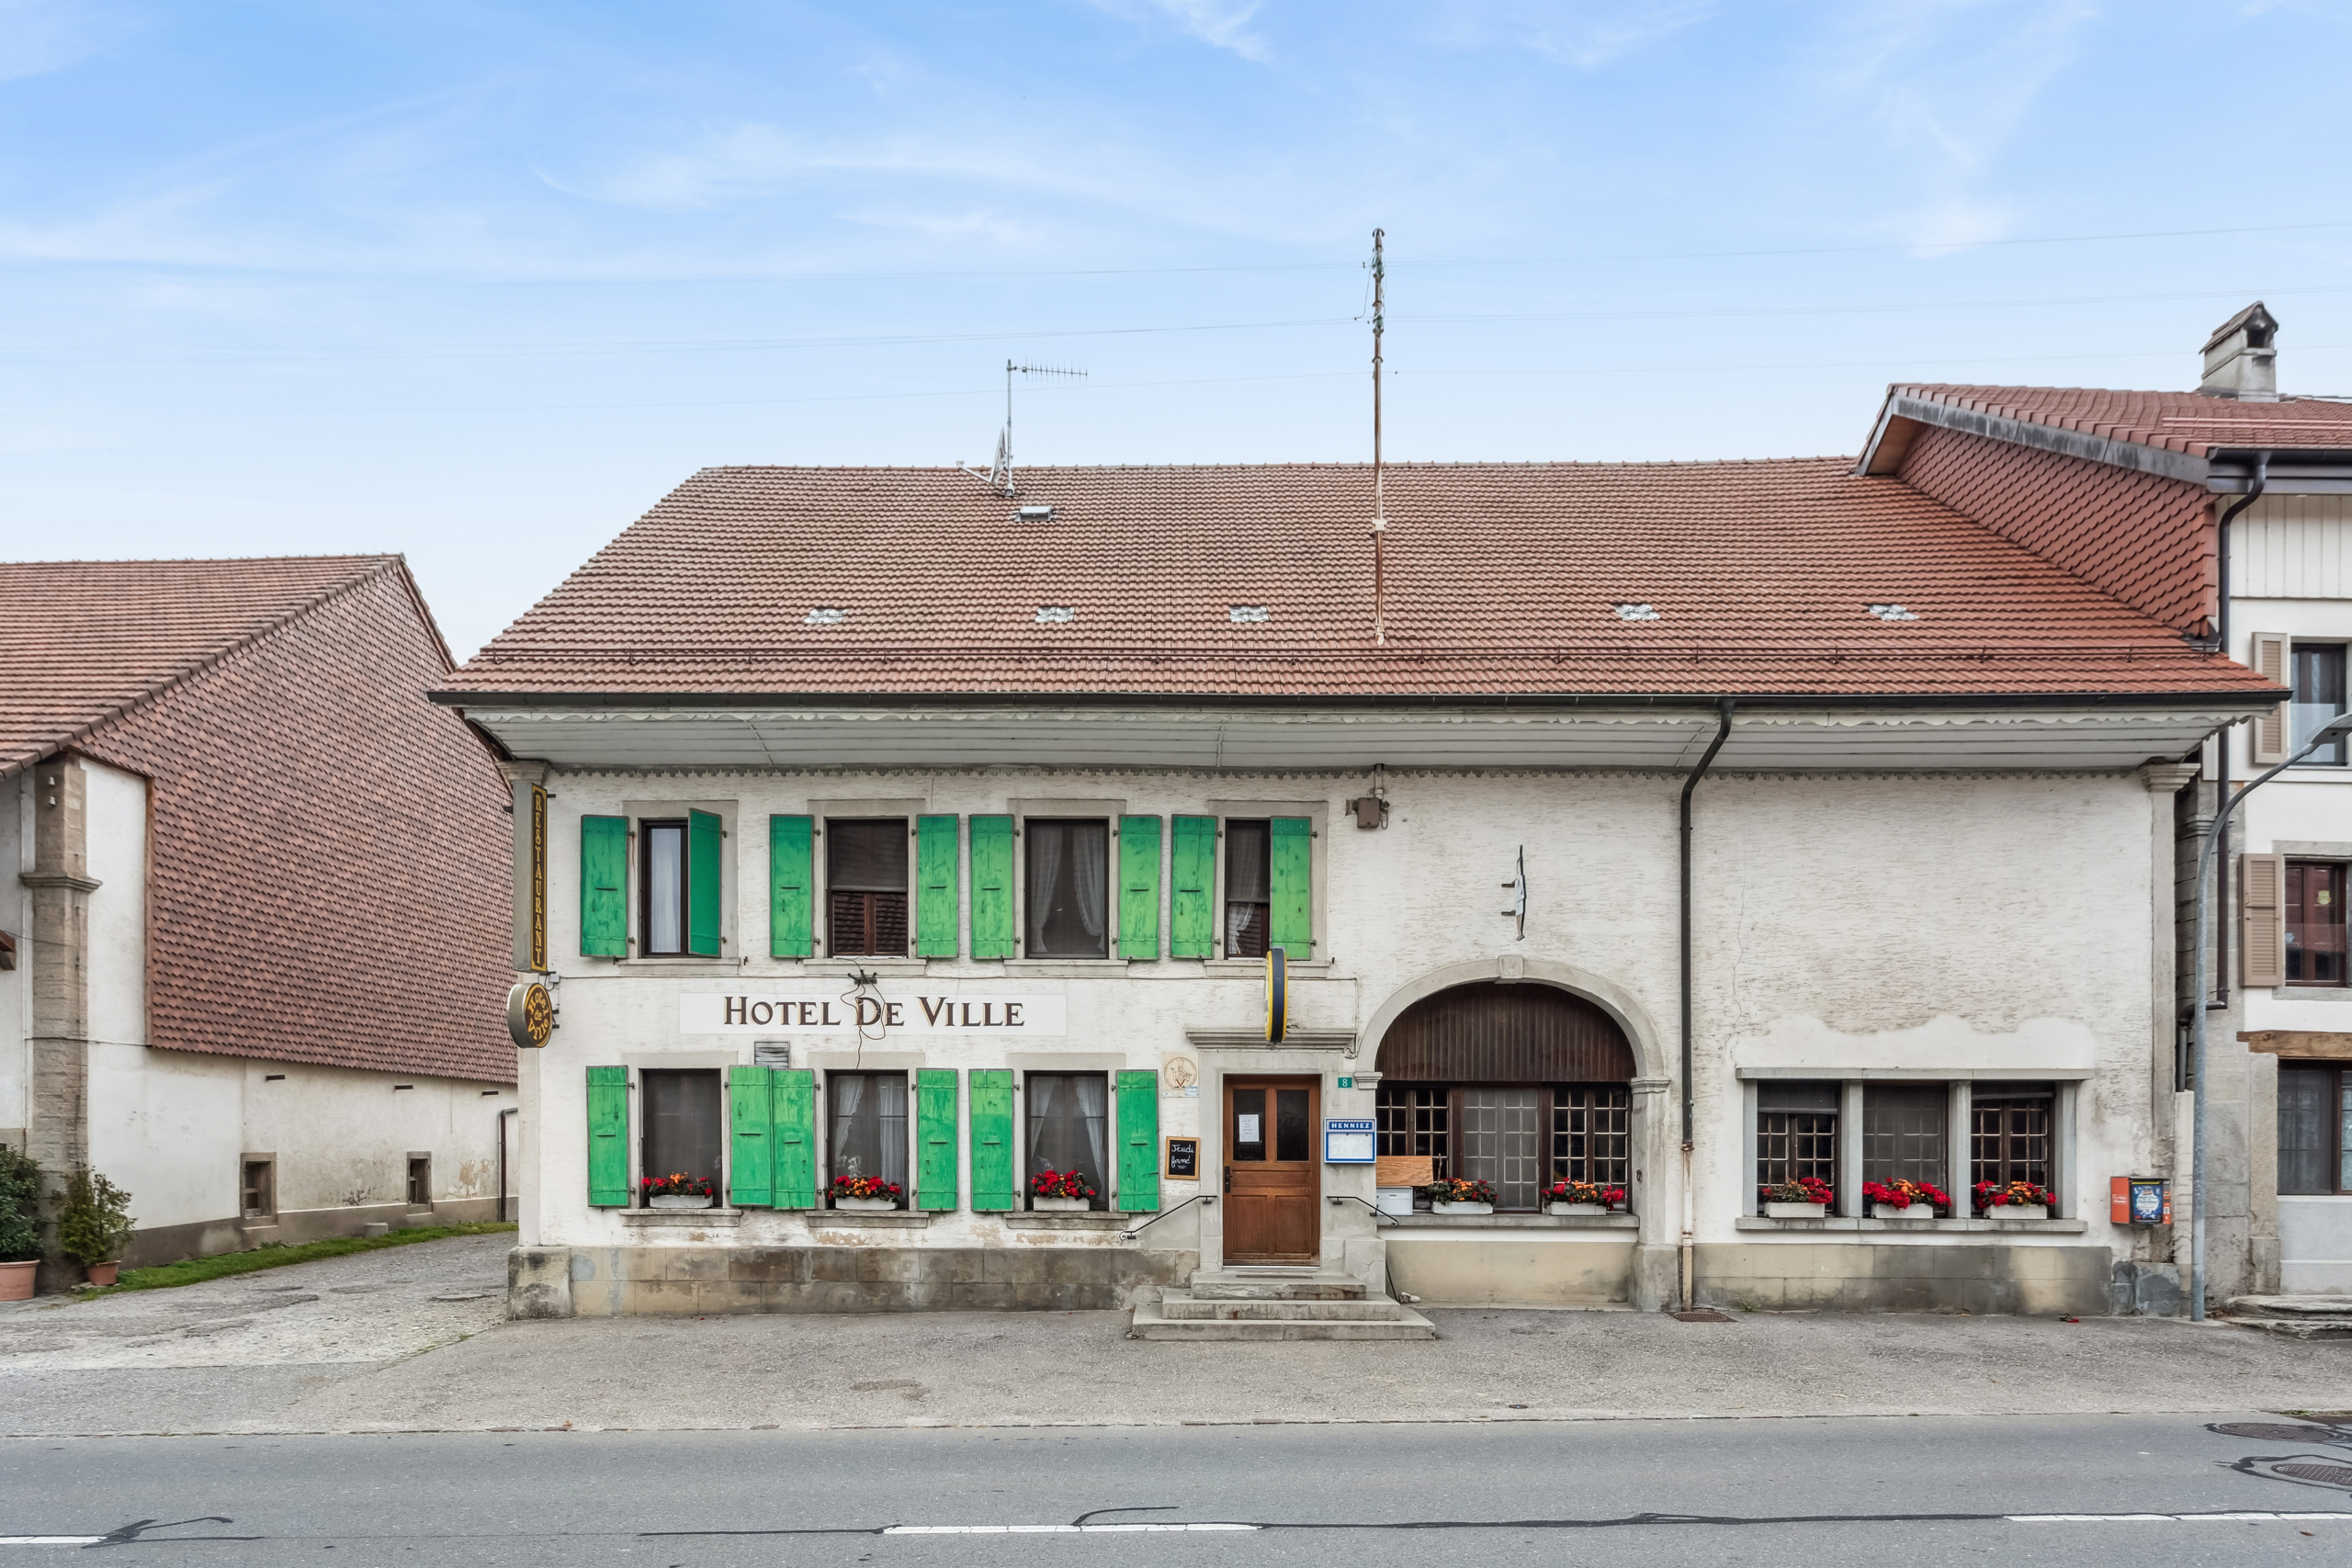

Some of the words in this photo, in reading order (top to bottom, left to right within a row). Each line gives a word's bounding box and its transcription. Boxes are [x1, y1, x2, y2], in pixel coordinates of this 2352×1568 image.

[534, 794, 543, 964] RESTAURANT
[527, 991, 548, 1015] Hotel
[534, 1010, 543, 1021] de
[527, 1018, 548, 1040] Ville
[1341, 1077, 1349, 1088] 8
[1171, 1144, 1194, 1153] Jeudi
